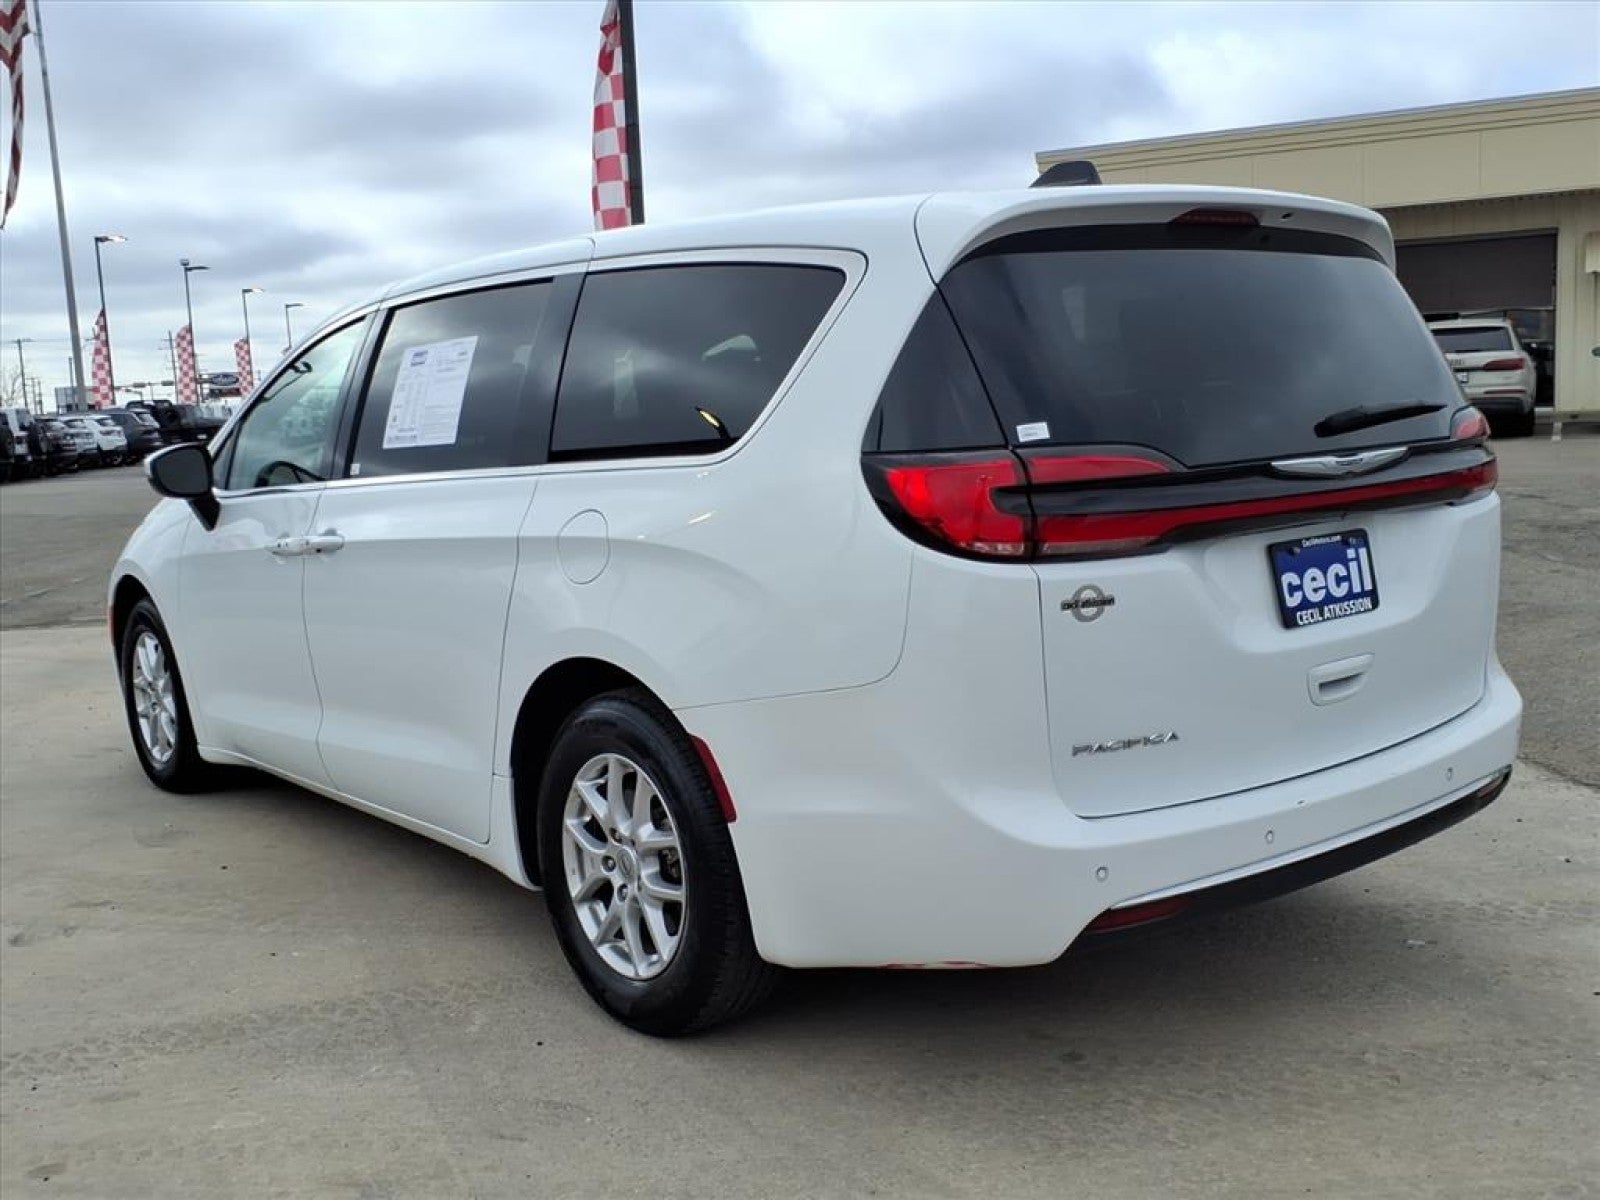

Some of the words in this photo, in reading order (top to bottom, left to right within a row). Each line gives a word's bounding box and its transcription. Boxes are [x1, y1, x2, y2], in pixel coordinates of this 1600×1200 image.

[1281, 547, 1373, 608] cecil
[1296, 608, 1323, 625] CECIL
[1324, 597, 1373, 619] ATKISSION
[1072, 731, 1179, 756] PACIFICA
